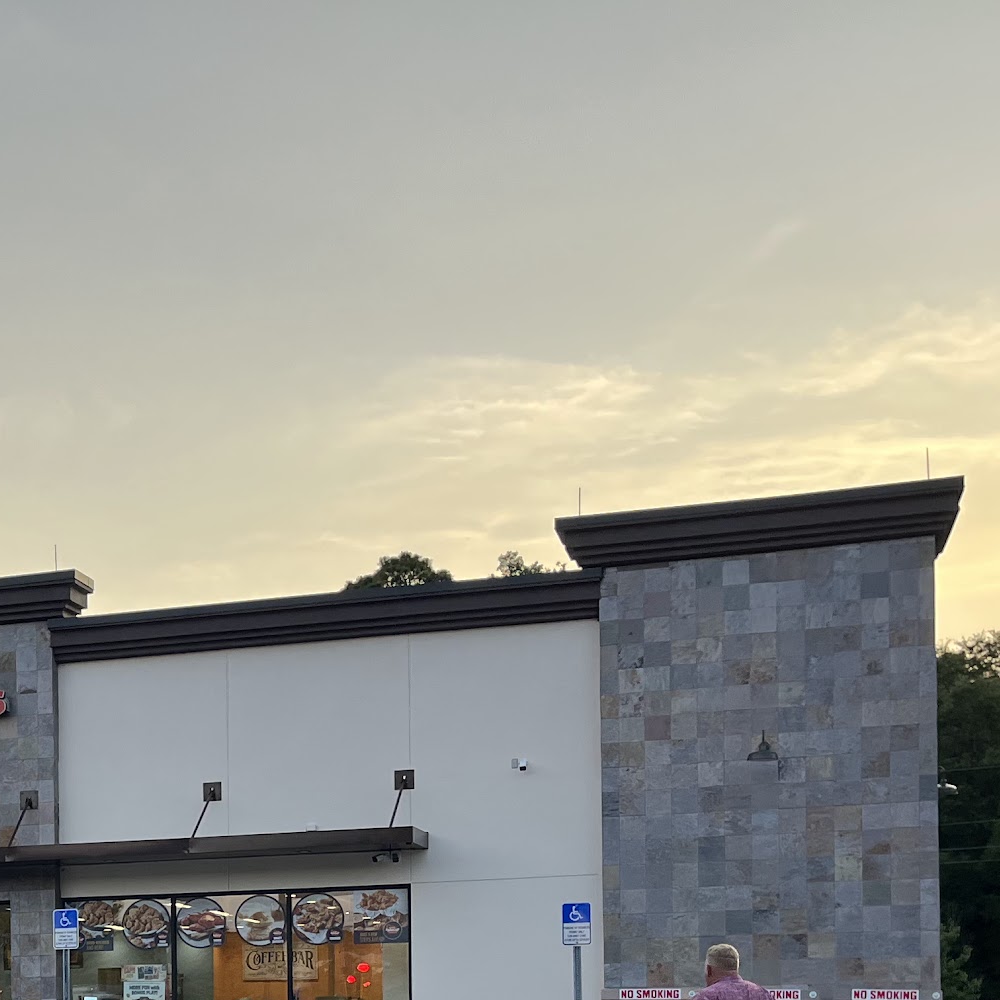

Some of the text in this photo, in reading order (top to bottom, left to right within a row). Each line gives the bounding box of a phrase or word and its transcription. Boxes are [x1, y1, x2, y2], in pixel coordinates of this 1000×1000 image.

[621, 990, 680, 999] NO SMOKING
[853, 990, 918, 1000] NO SMOKING
